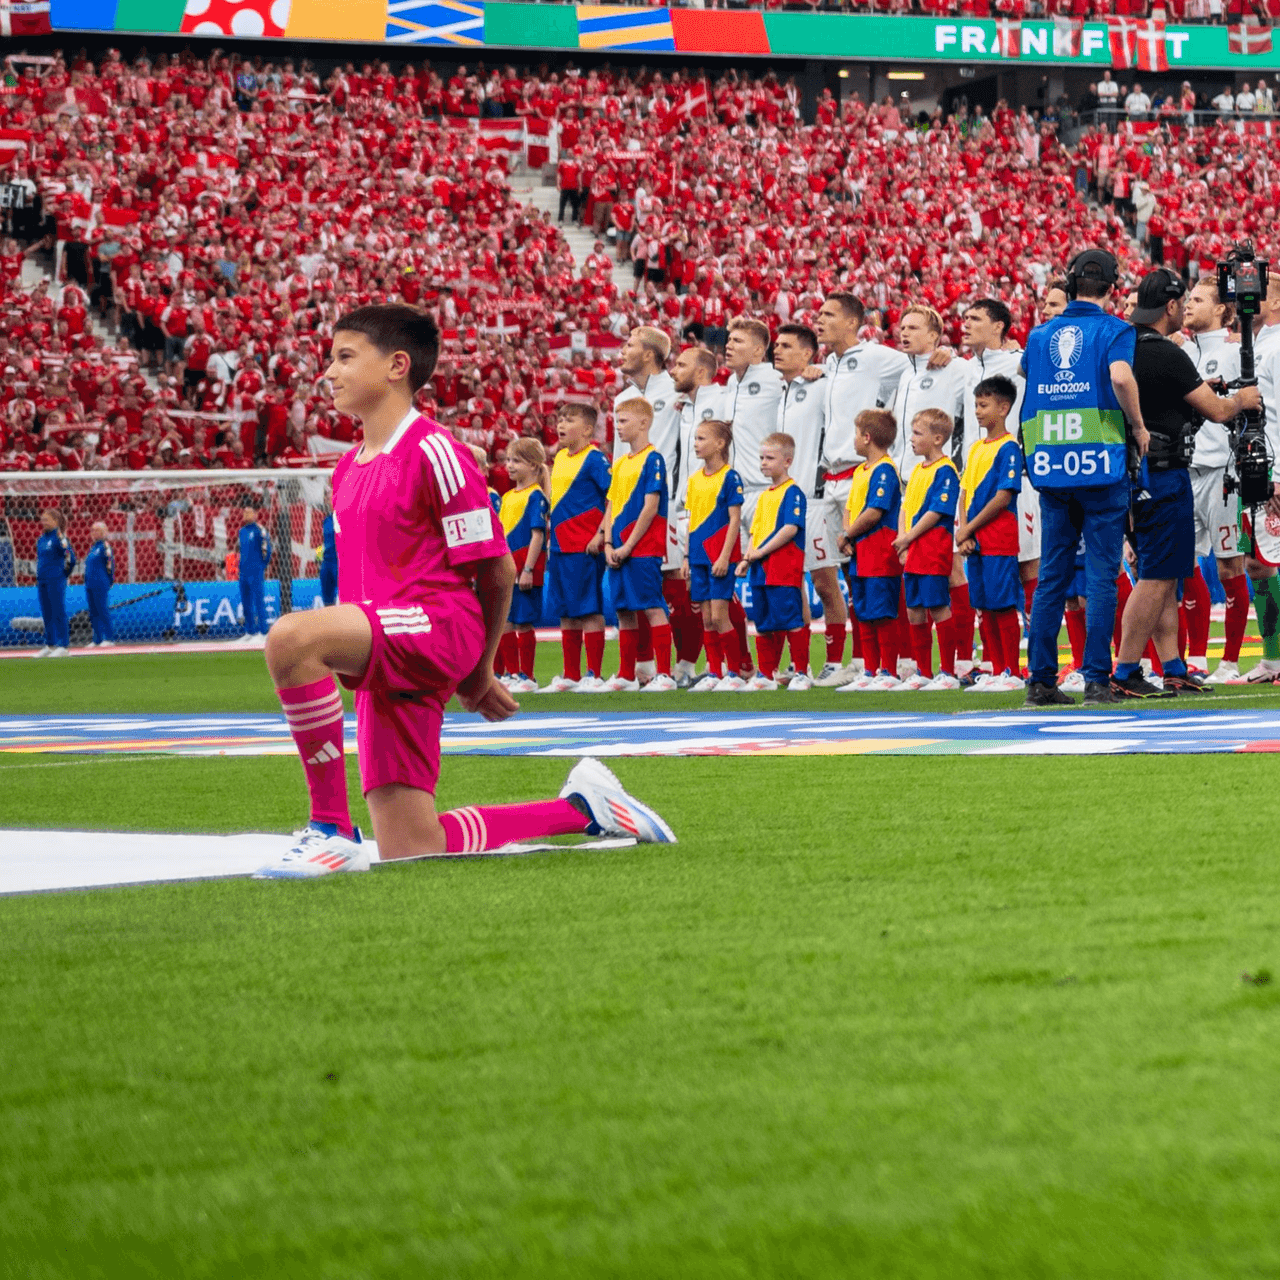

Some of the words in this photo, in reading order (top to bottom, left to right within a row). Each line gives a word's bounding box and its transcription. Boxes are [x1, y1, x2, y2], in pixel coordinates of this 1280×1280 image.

[1037, 382, 1090, 395] EURO2024
[1043, 412, 1083, 441] HB
[1033, 449, 1111, 476] 8-051
[812, 537, 826, 561] 5
